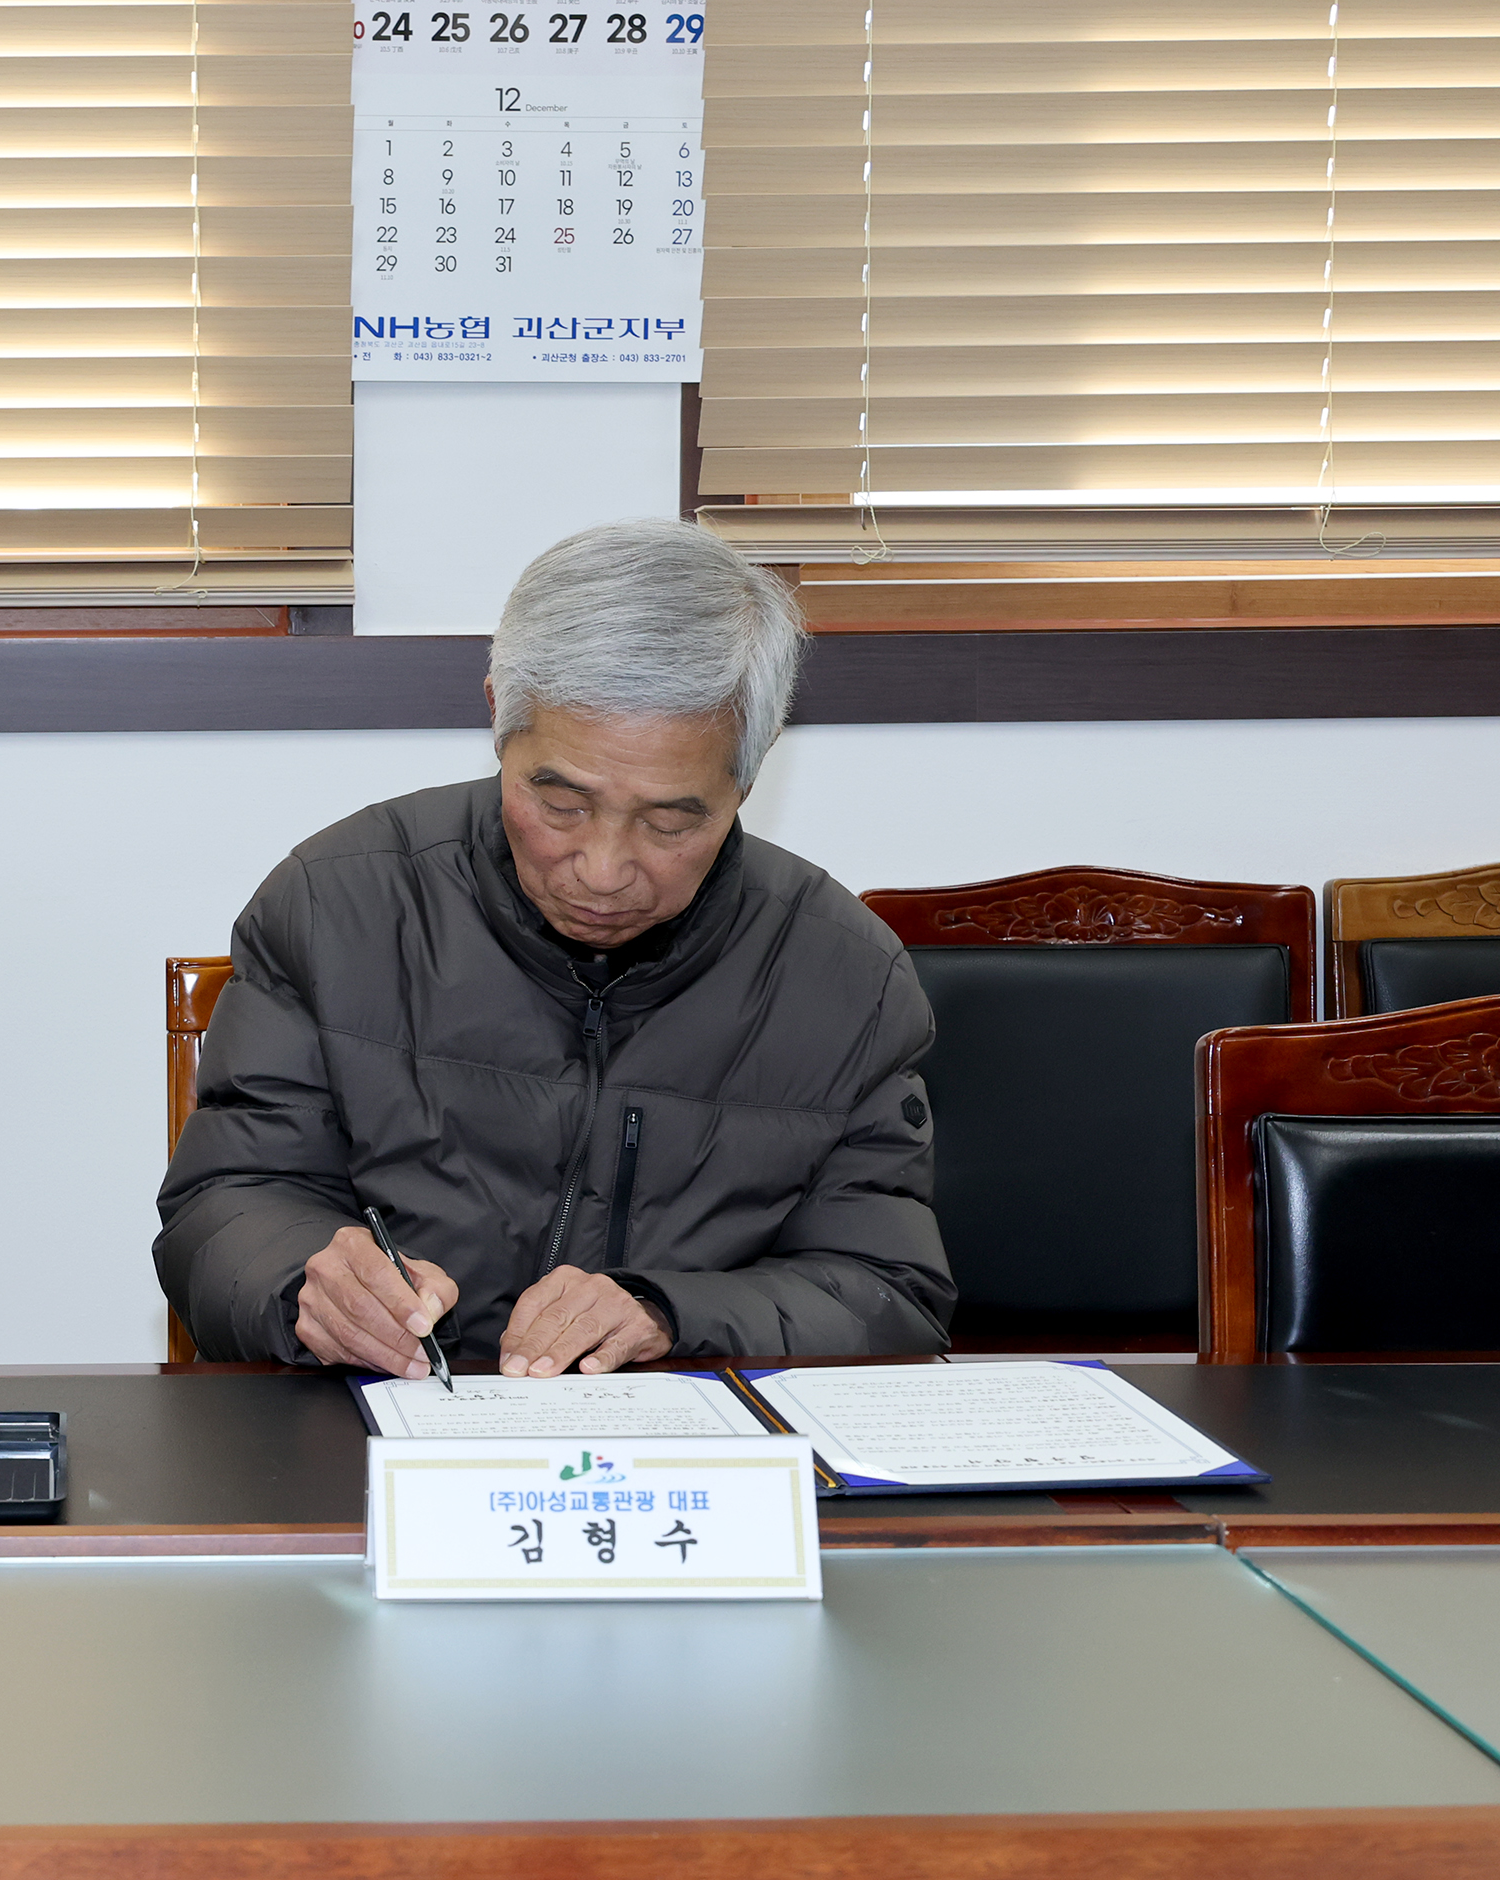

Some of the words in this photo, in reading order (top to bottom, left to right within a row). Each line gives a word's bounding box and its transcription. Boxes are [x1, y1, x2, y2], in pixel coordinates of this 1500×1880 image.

[371, 11, 414, 42] 24
[431, 11, 471, 43] 25
[489, 12, 530, 44] 26
[548, 13, 588, 43] 27
[606, 13, 647, 44] 28
[665, 13, 705, 44] 29
[495, 87, 521, 112] 12
[525, 103, 568, 112] December
[623, 121, 629, 129] 금
[385, 139, 392, 156] 1
[442, 139, 454, 157] 2
[501, 140, 513, 158] 3
[560, 141, 573, 158] 4
[620, 141, 631, 159] 5
[678, 142, 690, 159] 6
[383, 168, 394, 186] 8
[441, 168, 454, 186] 9
[498, 169, 516, 187] 10
[559, 169, 572, 187] 11
[616, 170, 634, 187] 12
[675, 170, 693, 188] 13
[379, 197, 397, 215] 15
[438, 197, 456, 215] 16
[498, 198, 515, 215] 17
[556, 198, 574, 216] 18
[615, 198, 633, 216] 19
[672, 199, 694, 217] 20
[376, 226, 398, 243] 22
[435, 226, 457, 244] 23
[494, 226, 517, 244] 24
[553, 227, 575, 245] 25
[612, 227, 635, 245] 26
[672, 228, 693, 245] 27
[376, 254, 398, 272] 29
[434, 255, 457, 273] 30
[495, 255, 512, 273] 31
[354, 315, 490, 340] NH농협
[512, 317, 685, 341] 괴산군지부
[362, 352, 371, 361] 전
[394, 352, 402, 361] 화
[413, 352, 433, 361] 043)
[437, 352, 492, 362] 833-0321~2
[542, 353, 577, 363] 괴산군청
[581, 353, 608, 363] 출장소
[619, 353, 639, 363] 043)
[643, 353, 686, 363] 833-2701
[490, 1490, 655, 1513] (주)아성교통관광
[668, 1490, 710, 1512] 대표
